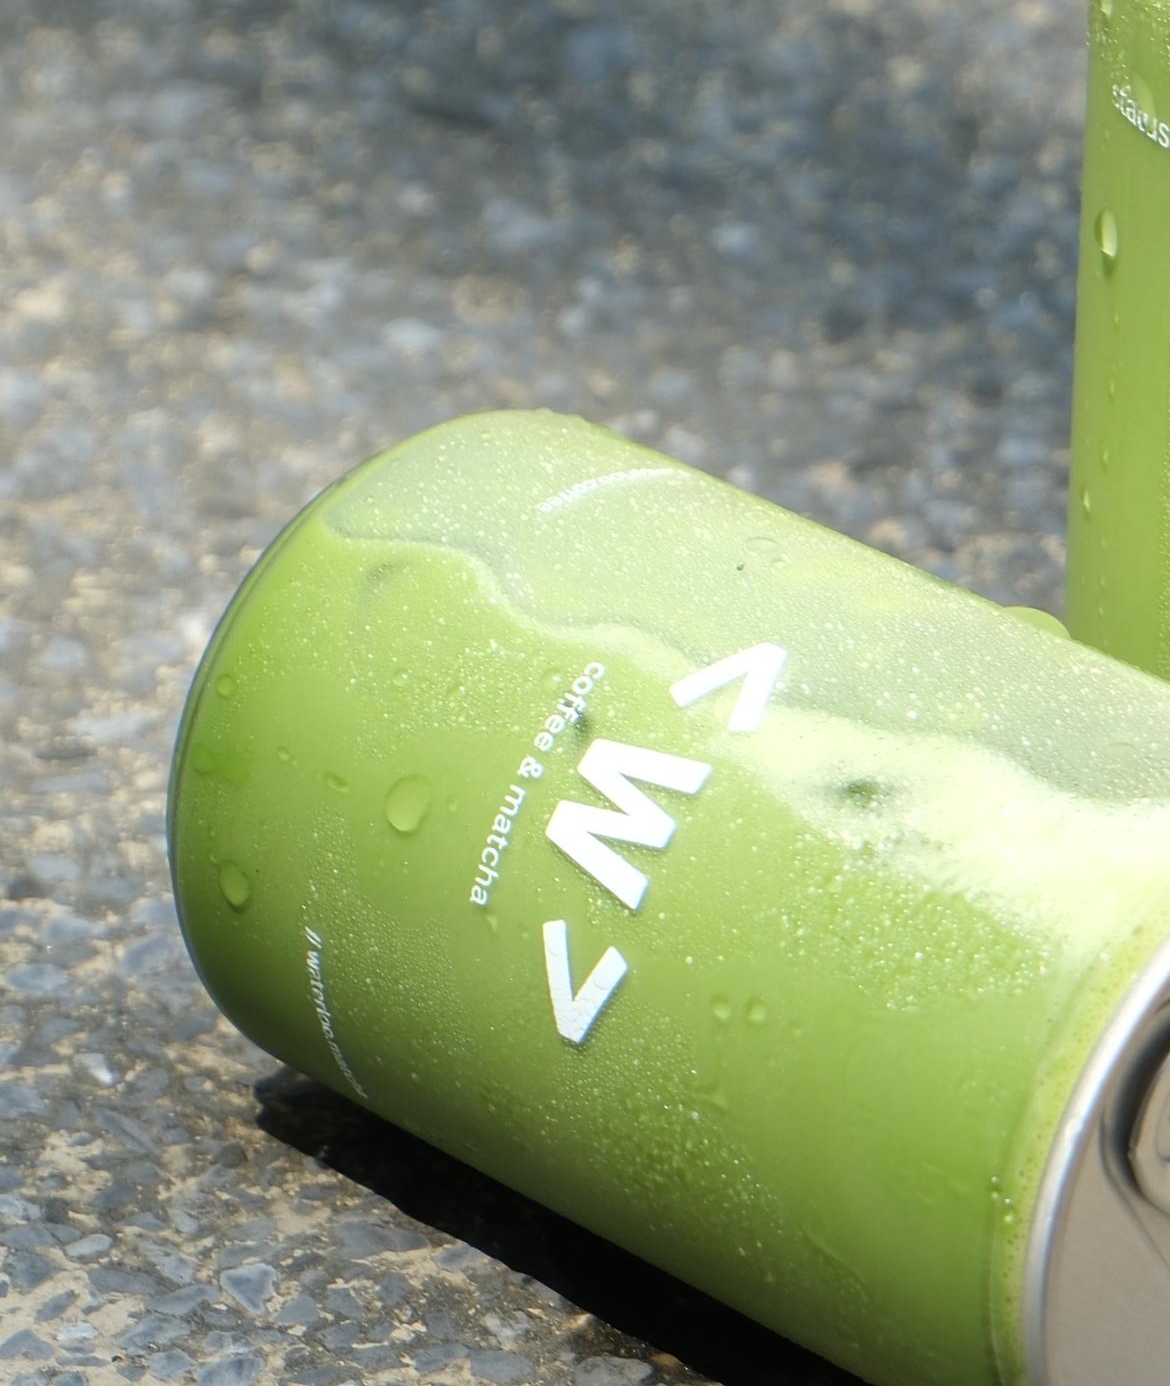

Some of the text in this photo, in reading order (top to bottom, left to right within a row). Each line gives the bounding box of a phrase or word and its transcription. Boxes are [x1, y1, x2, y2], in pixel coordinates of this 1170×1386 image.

[469, 661, 605, 907] coffee & matcha
